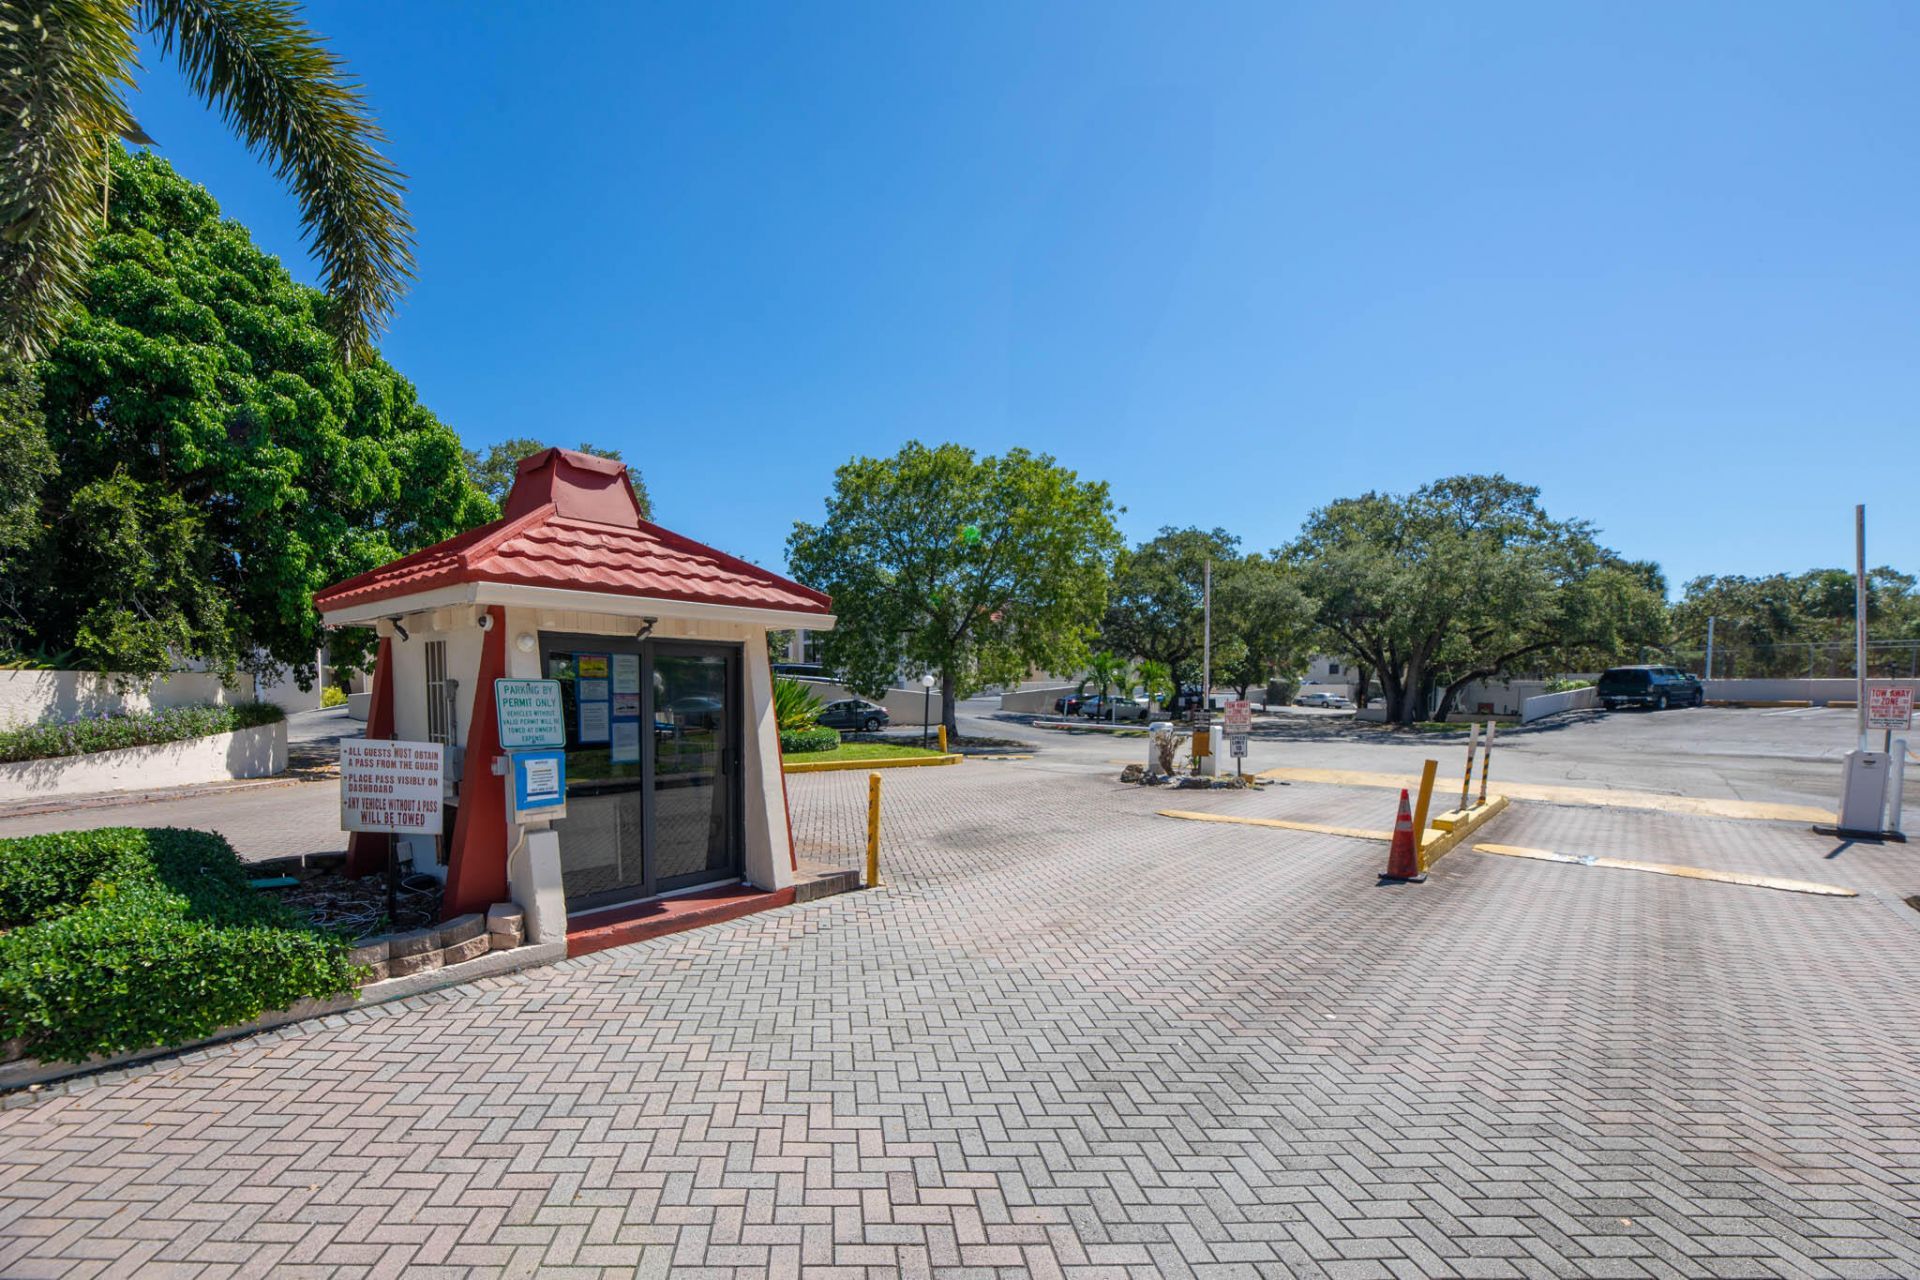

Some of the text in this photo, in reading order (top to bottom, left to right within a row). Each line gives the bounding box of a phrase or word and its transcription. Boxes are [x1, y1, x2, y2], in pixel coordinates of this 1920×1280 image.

[504, 685, 553, 694] PARKING BY
[1872, 689, 1910, 698] TOW AWAY
[503, 698, 556, 707] PERMIT ONLY
[348, 747, 438, 760] ALL GUESTS MUST OBTAIN
[348, 758, 438, 771] A PASS FROM THE GUARD
[348, 774, 438, 786] PLACE PASS VISIBLY ON
[348, 784, 394, 793] DASHBOARD
[348, 797, 438, 813] ANY VEHICLE WITHOUT A PASS
[361, 811, 425, 826] WILL BE TOWED
